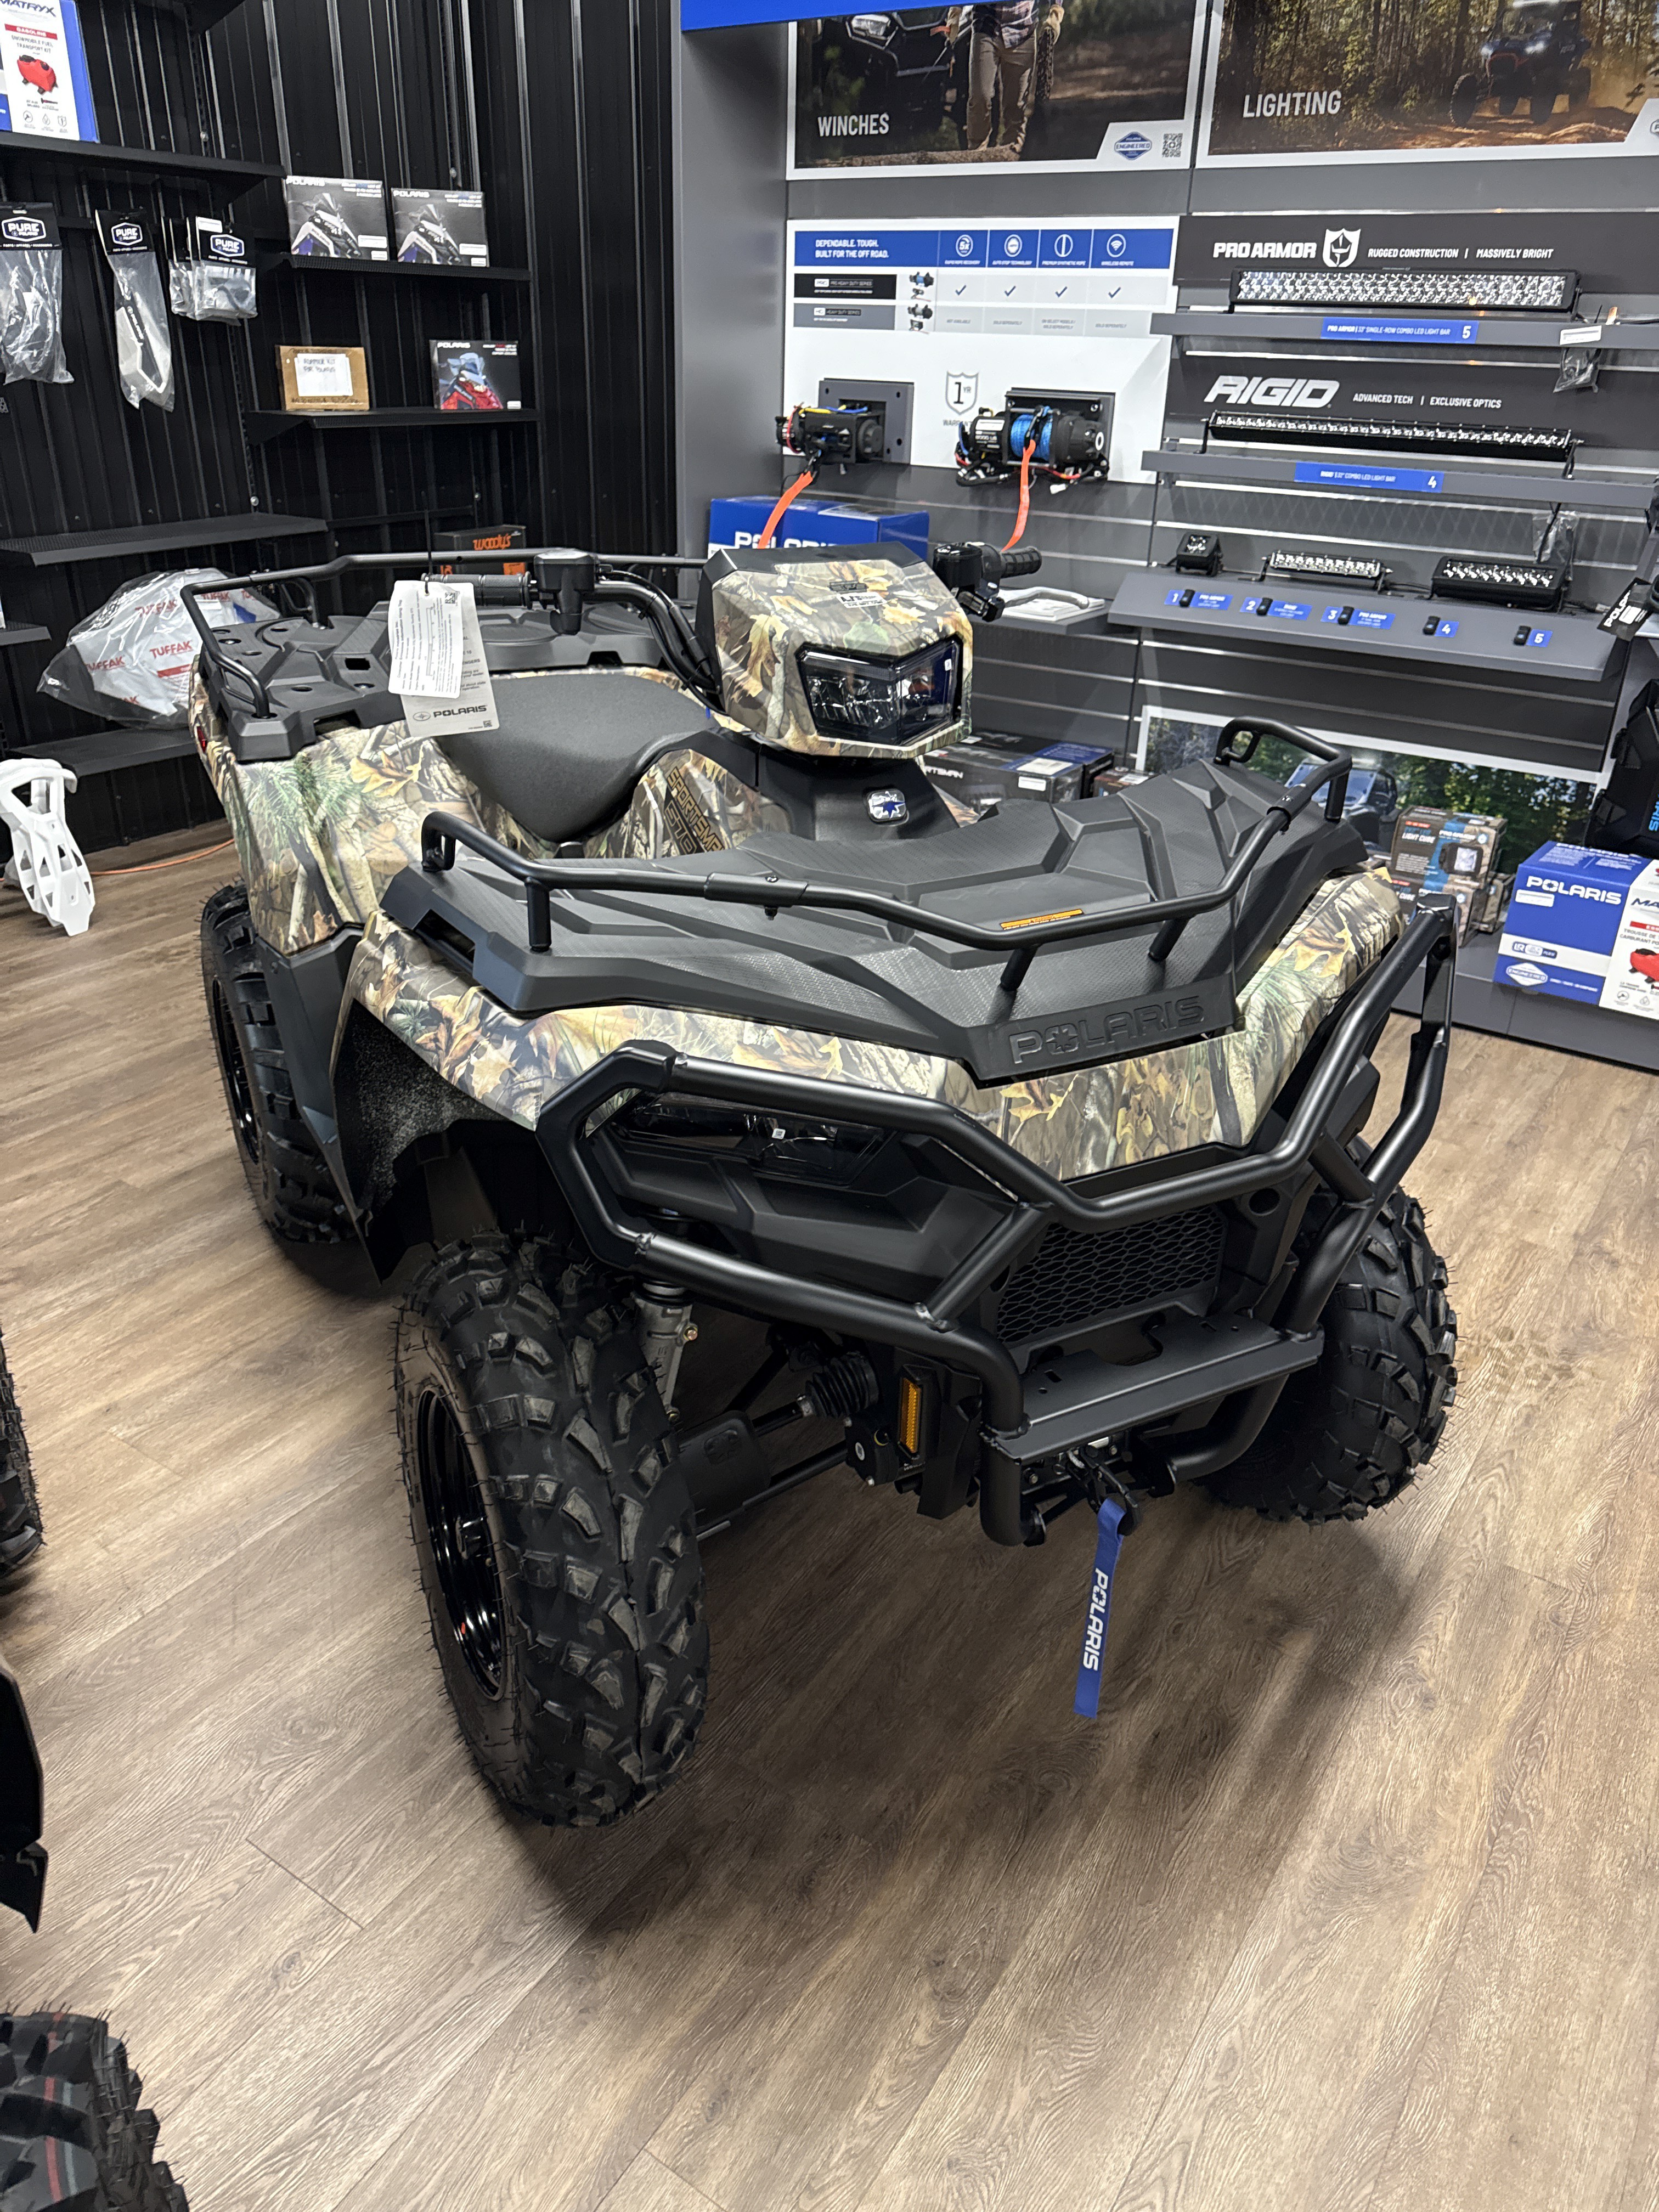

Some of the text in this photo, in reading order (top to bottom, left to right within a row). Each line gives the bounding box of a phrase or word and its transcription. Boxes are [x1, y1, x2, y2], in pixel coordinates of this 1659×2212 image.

[1243, 89, 1342, 118] LIGHTING
[817, 113, 890, 137] WINCHES
[8, 223, 40, 233] PURE
[116, 228, 138, 236] PURE
[215, 239, 240, 249] PURE
[815, 239, 879, 247] DEPENDABLE. TOUGH.
[870, 250, 889, 258] ROAD.
[1368, 248, 1554, 258] RUGGED CONSTRUCTION MASSIVELY BRIGHT
[1462, 325, 1472, 339] 5
[953, 382, 964, 404] 1
[1204, 375, 1340, 408] RIGID
[1352, 393, 1502, 409] ADVANCED TECH EXCLUSIVE OPTICS
[1427, 476, 1437, 489] 4
[1172, 593, 1179, 603] 1
[1245, 600, 1256, 611] 2
[1328, 610, 1338, 620] 3
[1441, 624, 1451, 634] 4
[1534, 633, 1544, 644] 5
[150, 640, 192, 659] TUFFAK
[433, 704, 487, 718] POLARIS
[667, 766, 725, 852] SPORTSMA
[664, 799, 697, 855] 570
[1401, 832, 1436, 844] LIGHT CUBE
[1399, 893, 1416, 901] CUBE
[1526, 876, 1622, 905] POLARIS
[1008, 995, 1205, 1064] POLARIS
[1082, 1567, 1109, 1672] POLARIS
